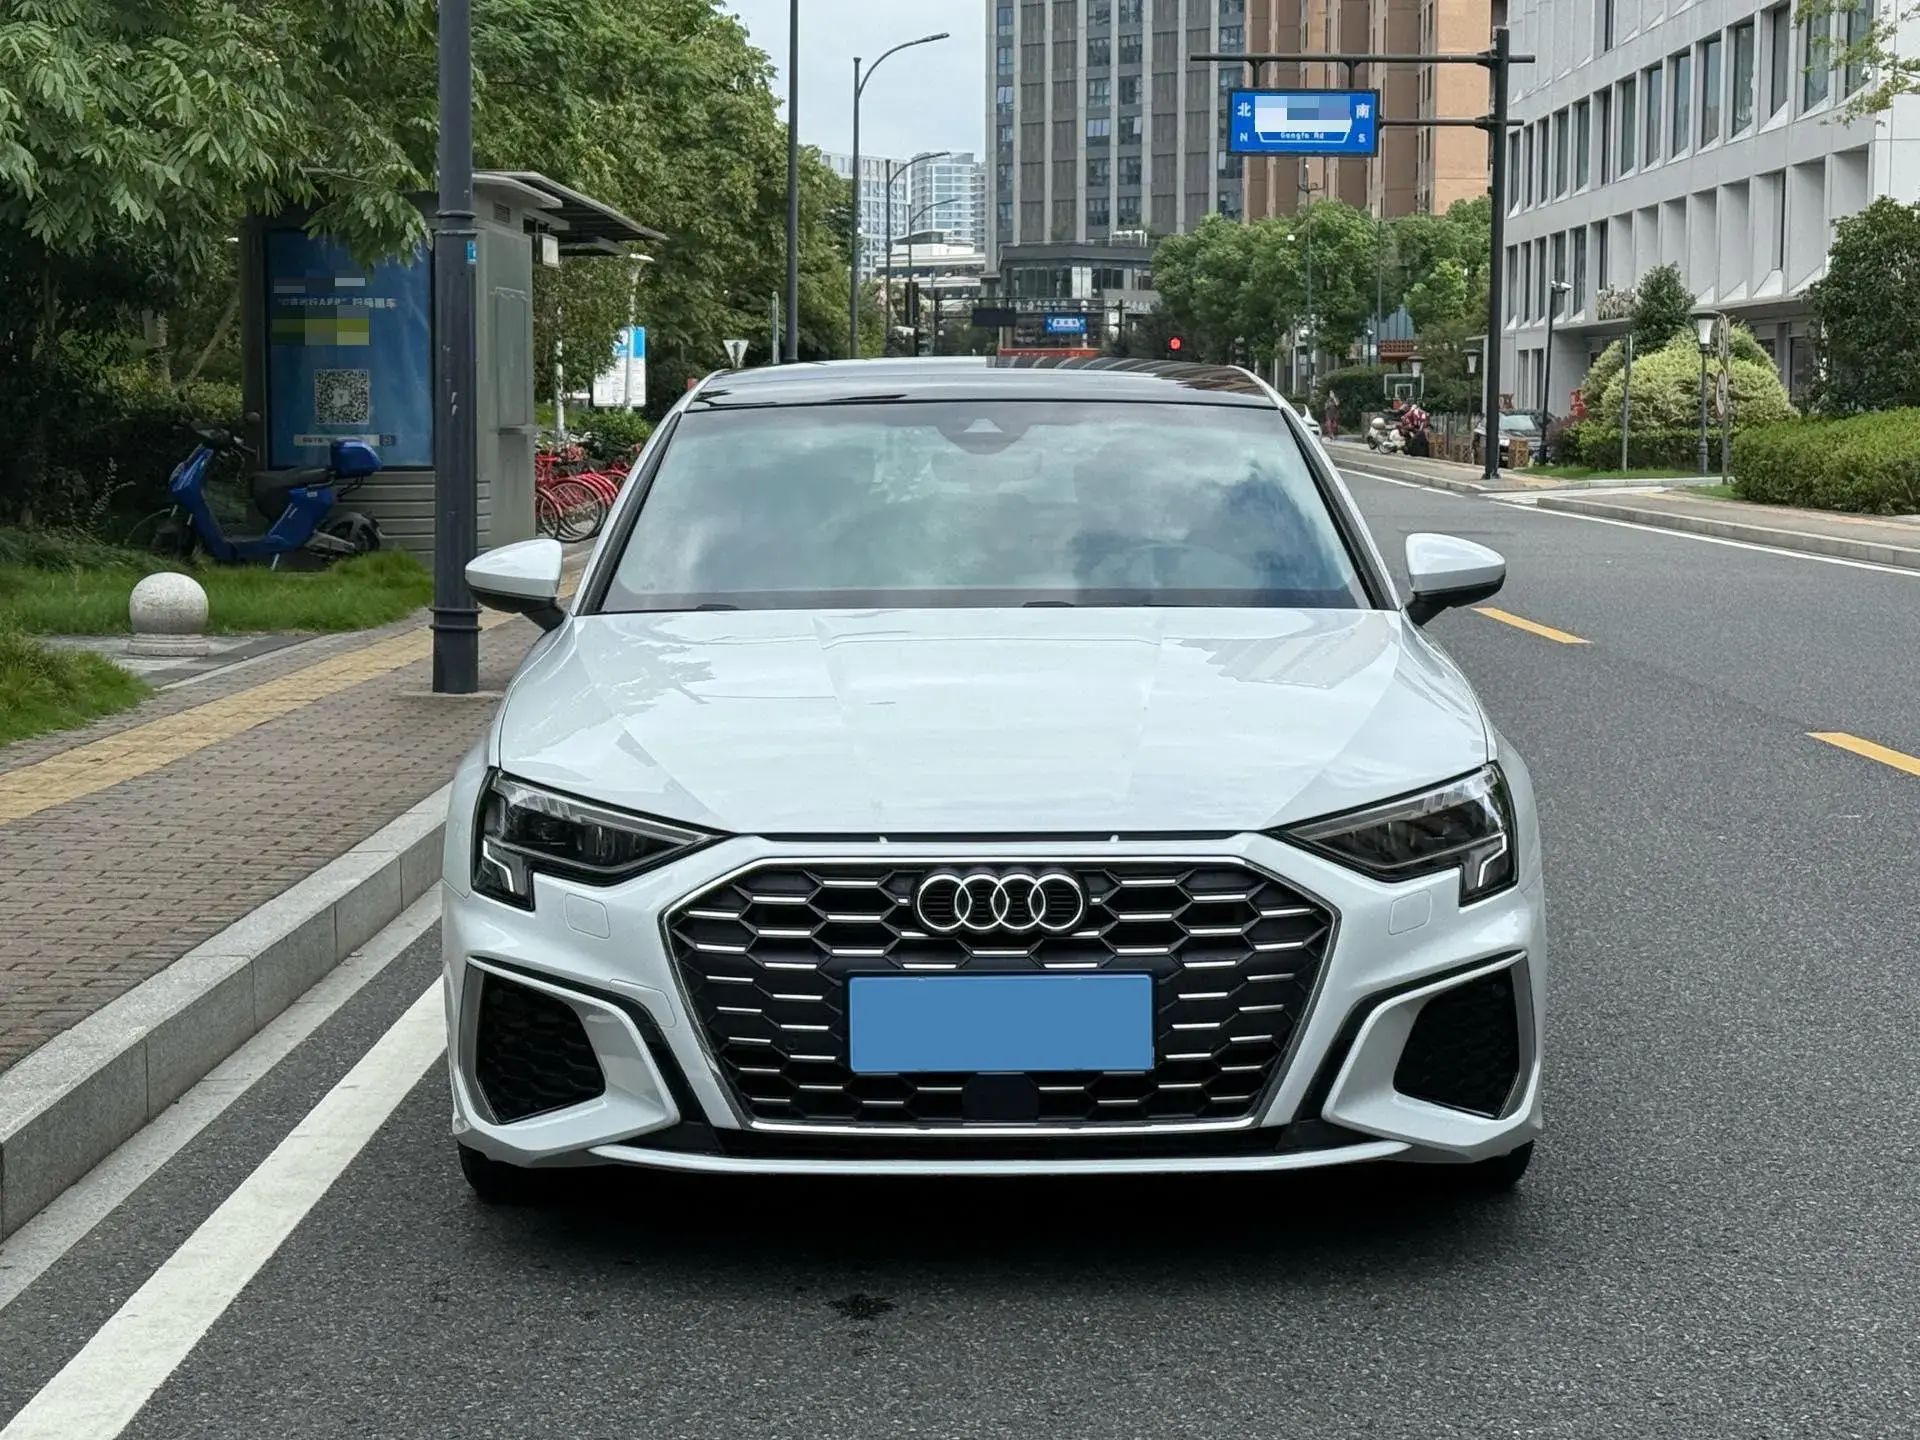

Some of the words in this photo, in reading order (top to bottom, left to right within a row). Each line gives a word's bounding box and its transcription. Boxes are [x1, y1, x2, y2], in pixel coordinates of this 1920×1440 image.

[1237, 102, 1252, 117] 北
[1355, 103, 1371, 119] 南
[1239, 132, 1249, 142] N
[1358, 133, 1366, 143] S
